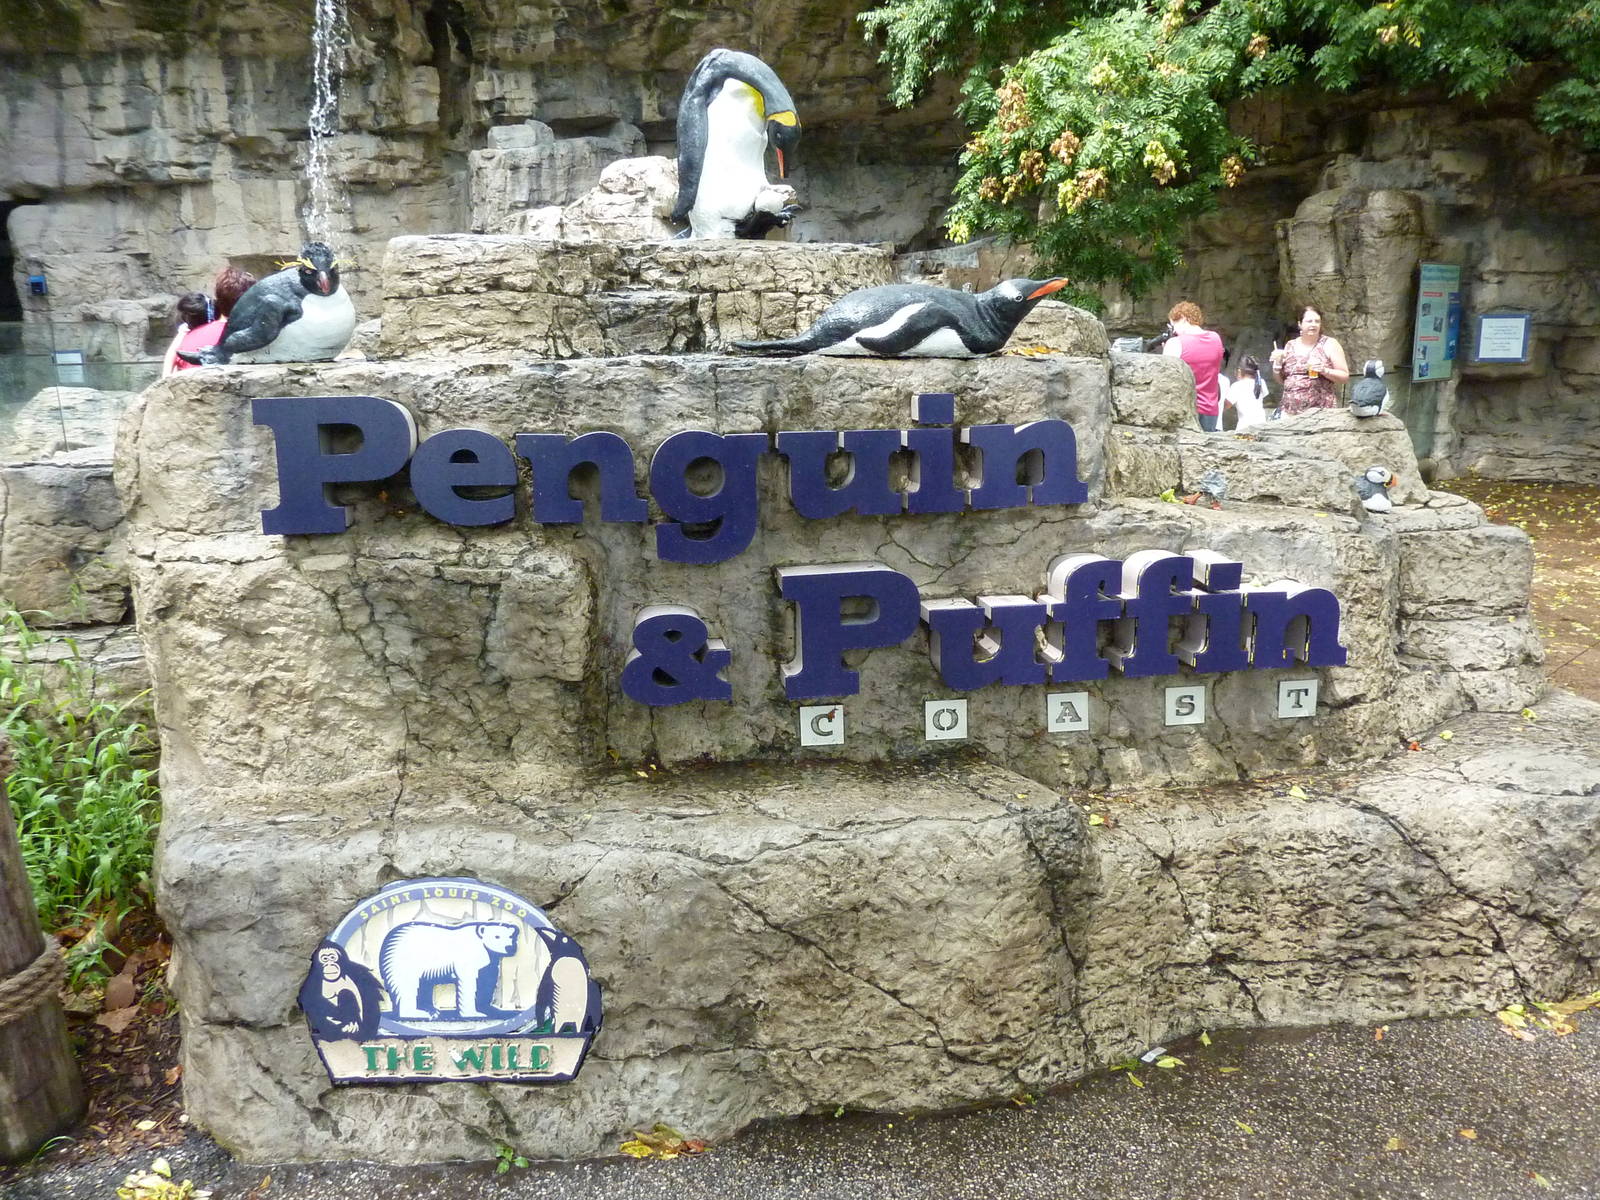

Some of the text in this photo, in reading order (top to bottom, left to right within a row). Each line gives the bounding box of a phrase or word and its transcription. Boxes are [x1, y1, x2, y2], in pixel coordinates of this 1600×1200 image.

[252, 393, 1089, 564] Penguin
[621, 549, 1348, 706] & Puffin
[359, 891, 411, 920] SAINT
[491, 896, 528, 918] ZOO
[361, 1043, 552, 1073] THE WILD
